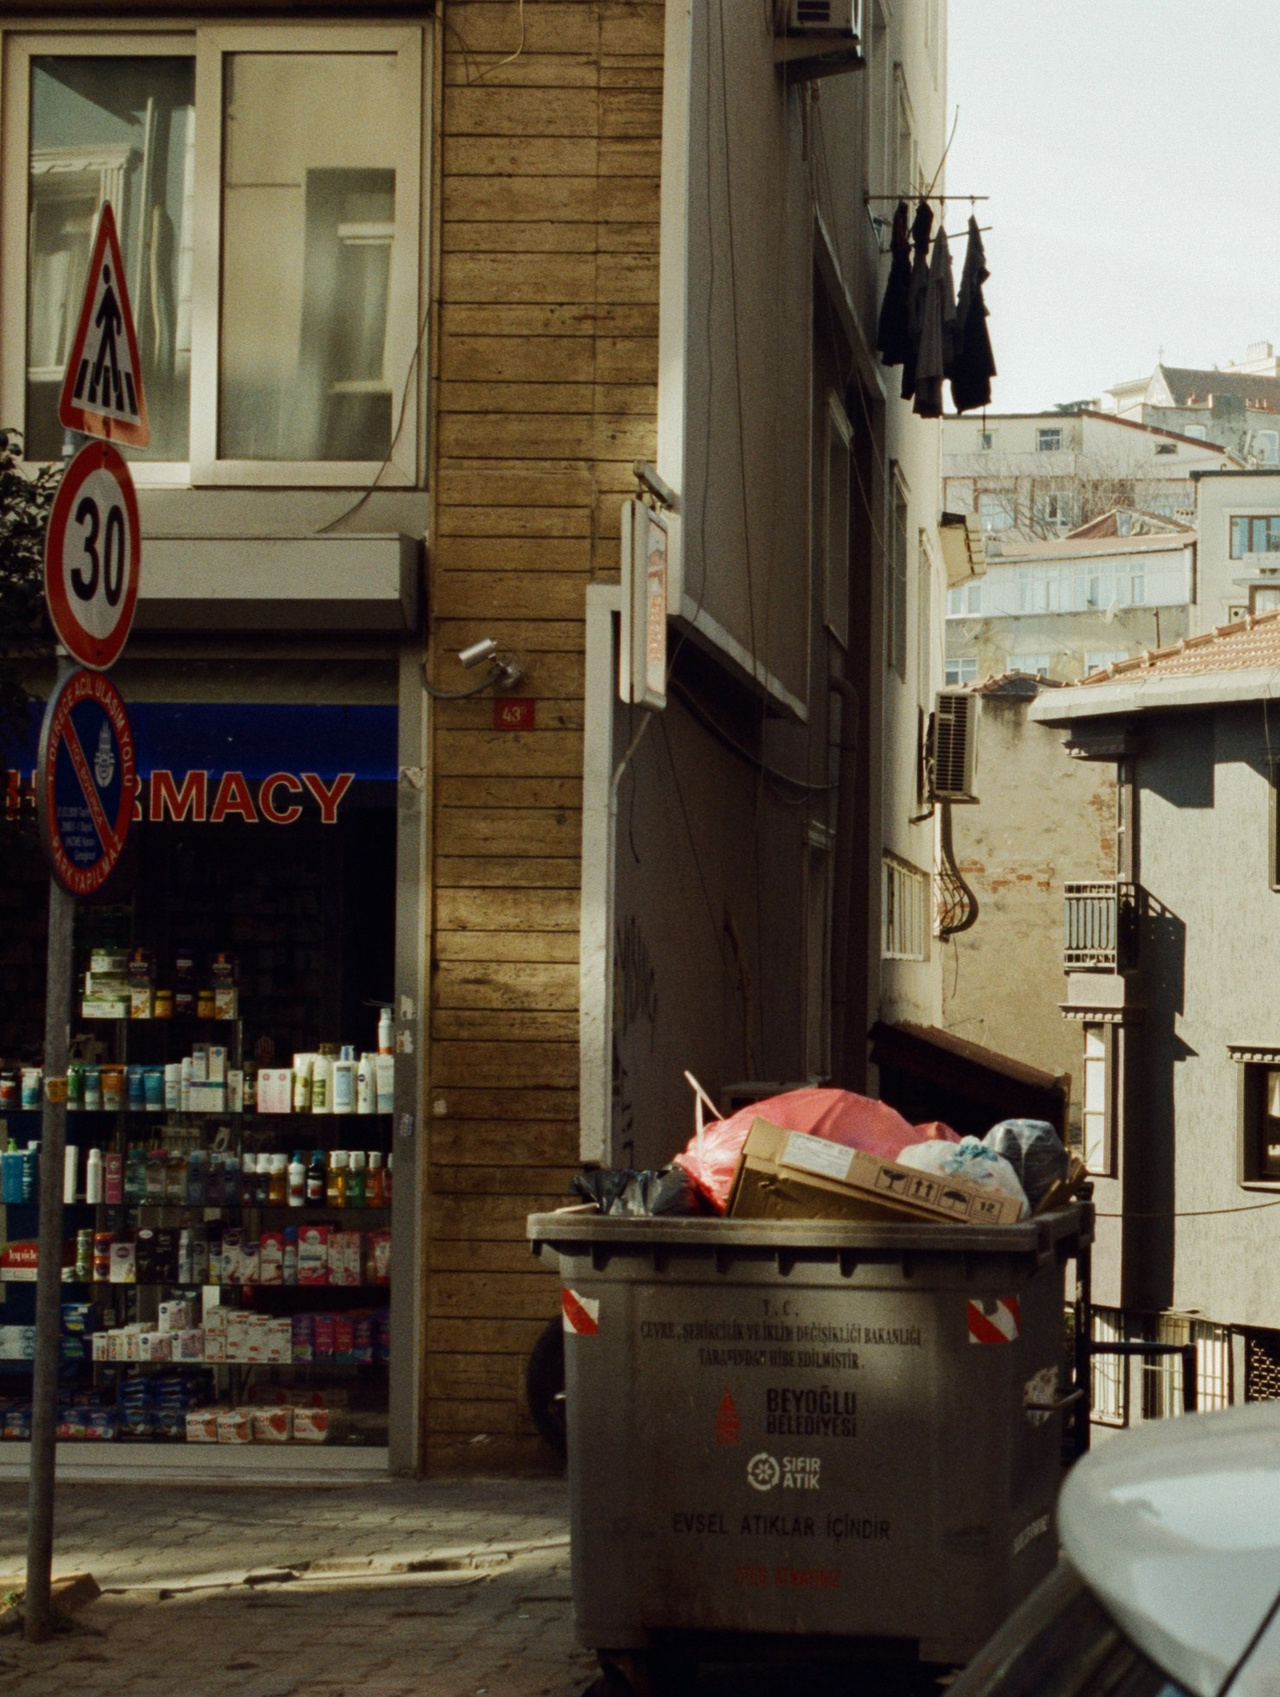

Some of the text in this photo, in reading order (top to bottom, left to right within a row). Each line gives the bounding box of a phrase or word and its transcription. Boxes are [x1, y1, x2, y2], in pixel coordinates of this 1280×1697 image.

[70, 496, 125, 608] 30
[121, 731, 134, 787] YOLU
[979, 1200, 996, 1214] 12
[766, 1385, 857, 1416] BEYOĞLU
[766, 1414, 857, 1438] BELEDİYESİ
[782, 1456, 822, 1473] SIFIR
[782, 1472, 821, 1490] ATIK
[672, 1512, 729, 1535] EVSEL
[826, 1513, 891, 1543] İÇİNDİR
